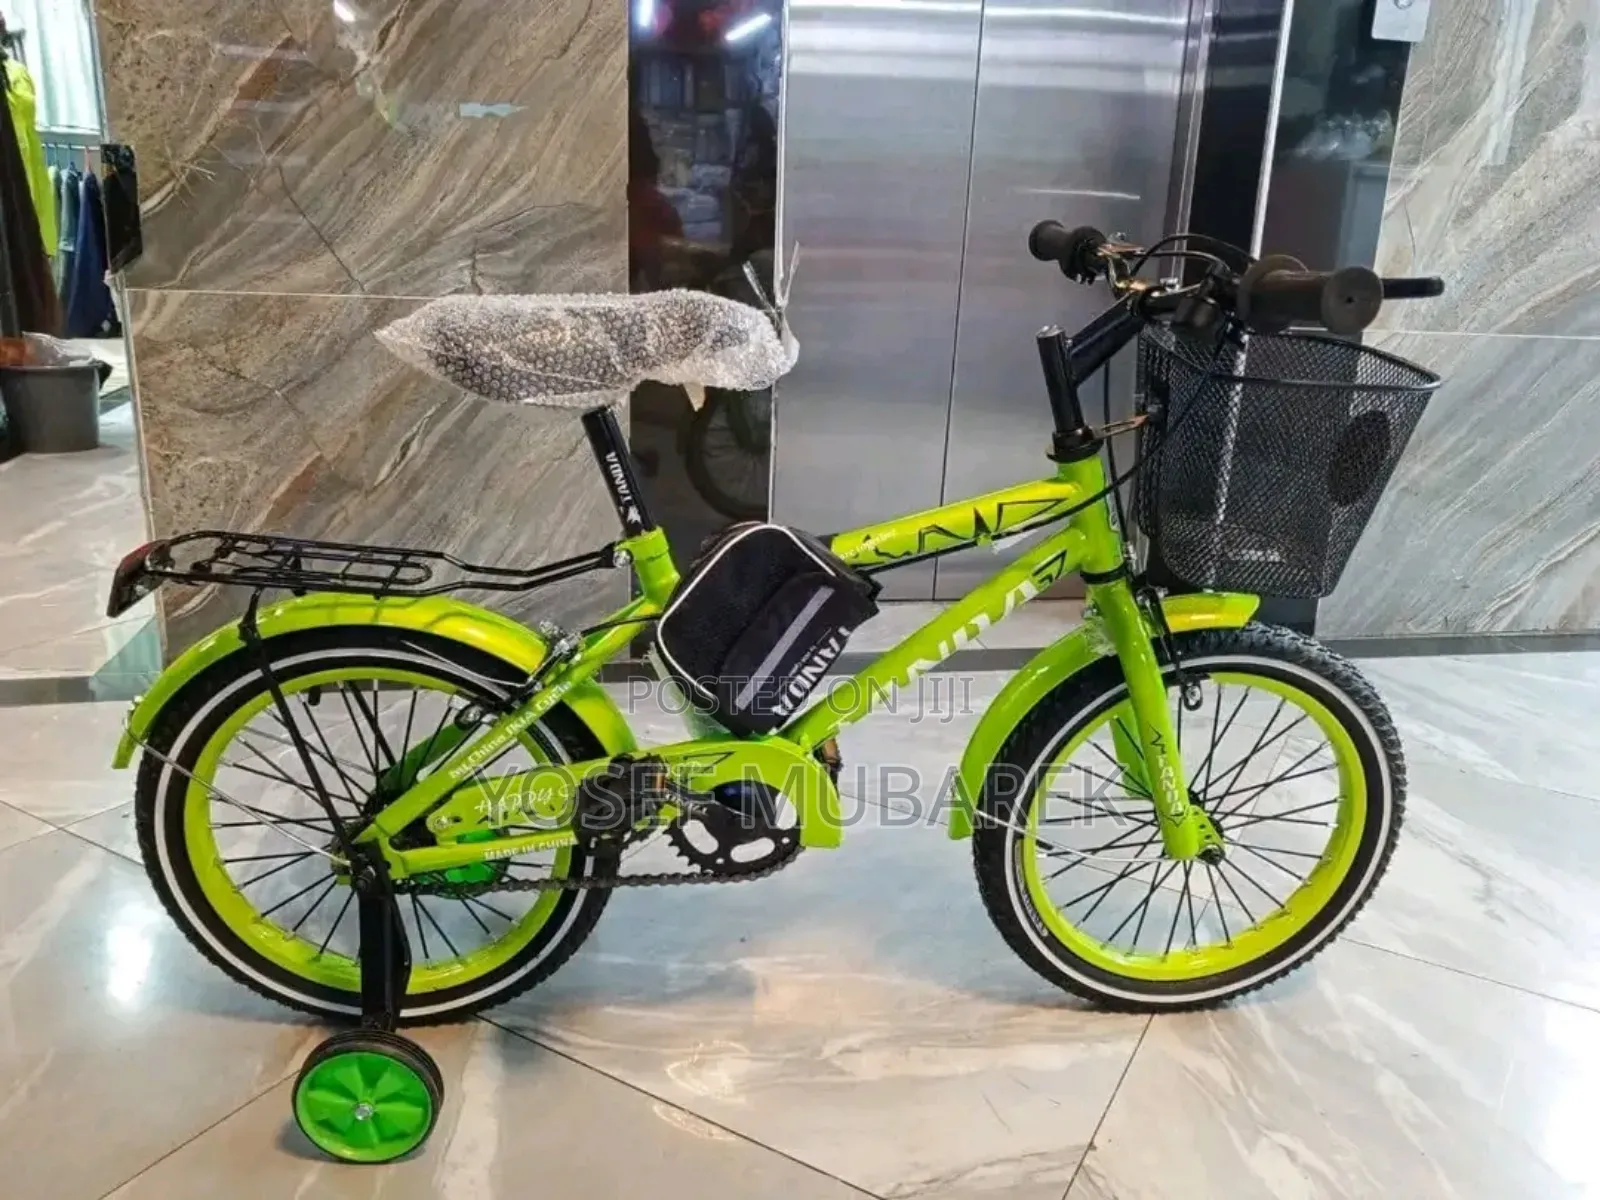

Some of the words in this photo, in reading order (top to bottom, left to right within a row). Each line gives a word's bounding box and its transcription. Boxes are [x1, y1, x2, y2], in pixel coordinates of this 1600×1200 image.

[605, 451, 632, 504] TANDA
[770, 626, 851, 716] TANDA
[1156, 754, 1184, 817] TANDA
